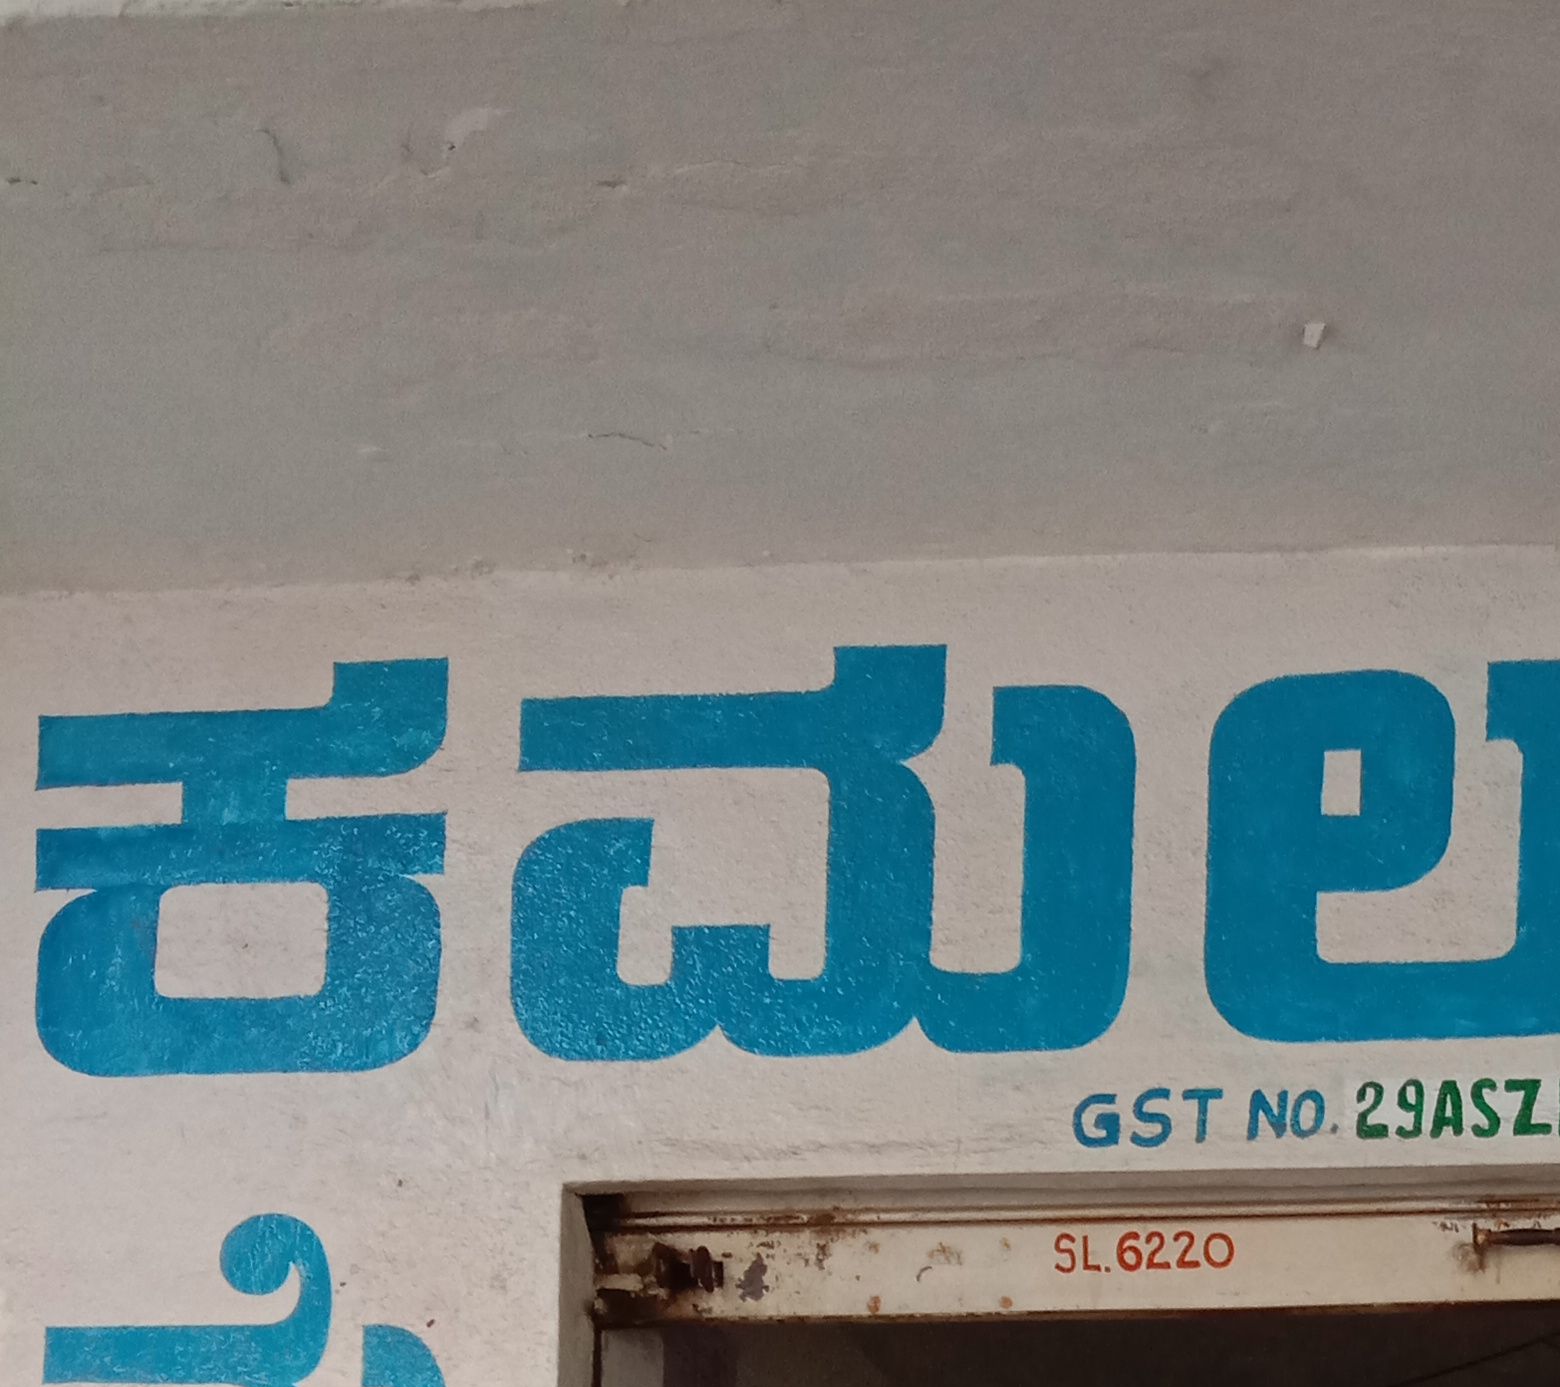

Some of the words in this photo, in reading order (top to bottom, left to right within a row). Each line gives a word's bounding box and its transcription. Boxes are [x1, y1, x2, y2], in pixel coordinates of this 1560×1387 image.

[1073, 1087, 1226, 1148] GST
[1247, 1089, 1340, 1139] NO.
[1053, 1230, 1236, 1274] SL.6220
